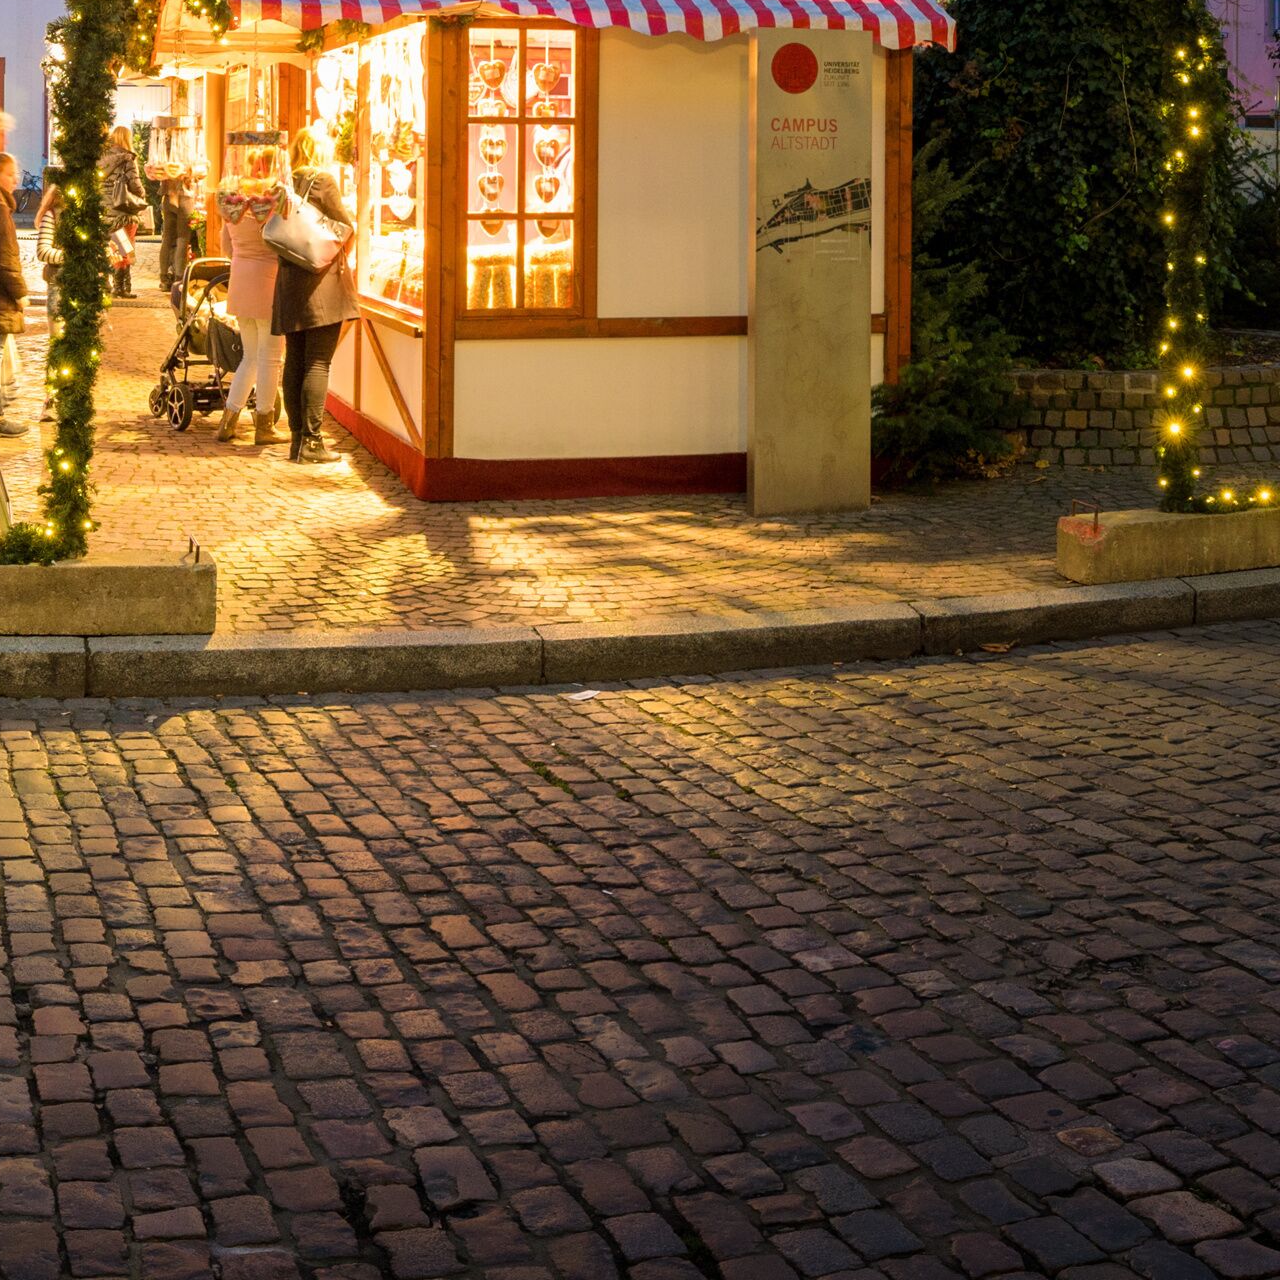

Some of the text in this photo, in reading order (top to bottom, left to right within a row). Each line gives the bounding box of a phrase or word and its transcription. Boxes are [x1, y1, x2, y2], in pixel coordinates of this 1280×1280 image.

[823, 67, 860, 75] HEIDELBERG
[770, 117, 839, 133] CAMPUS
[770, 135, 839, 151] ALTSTADT
